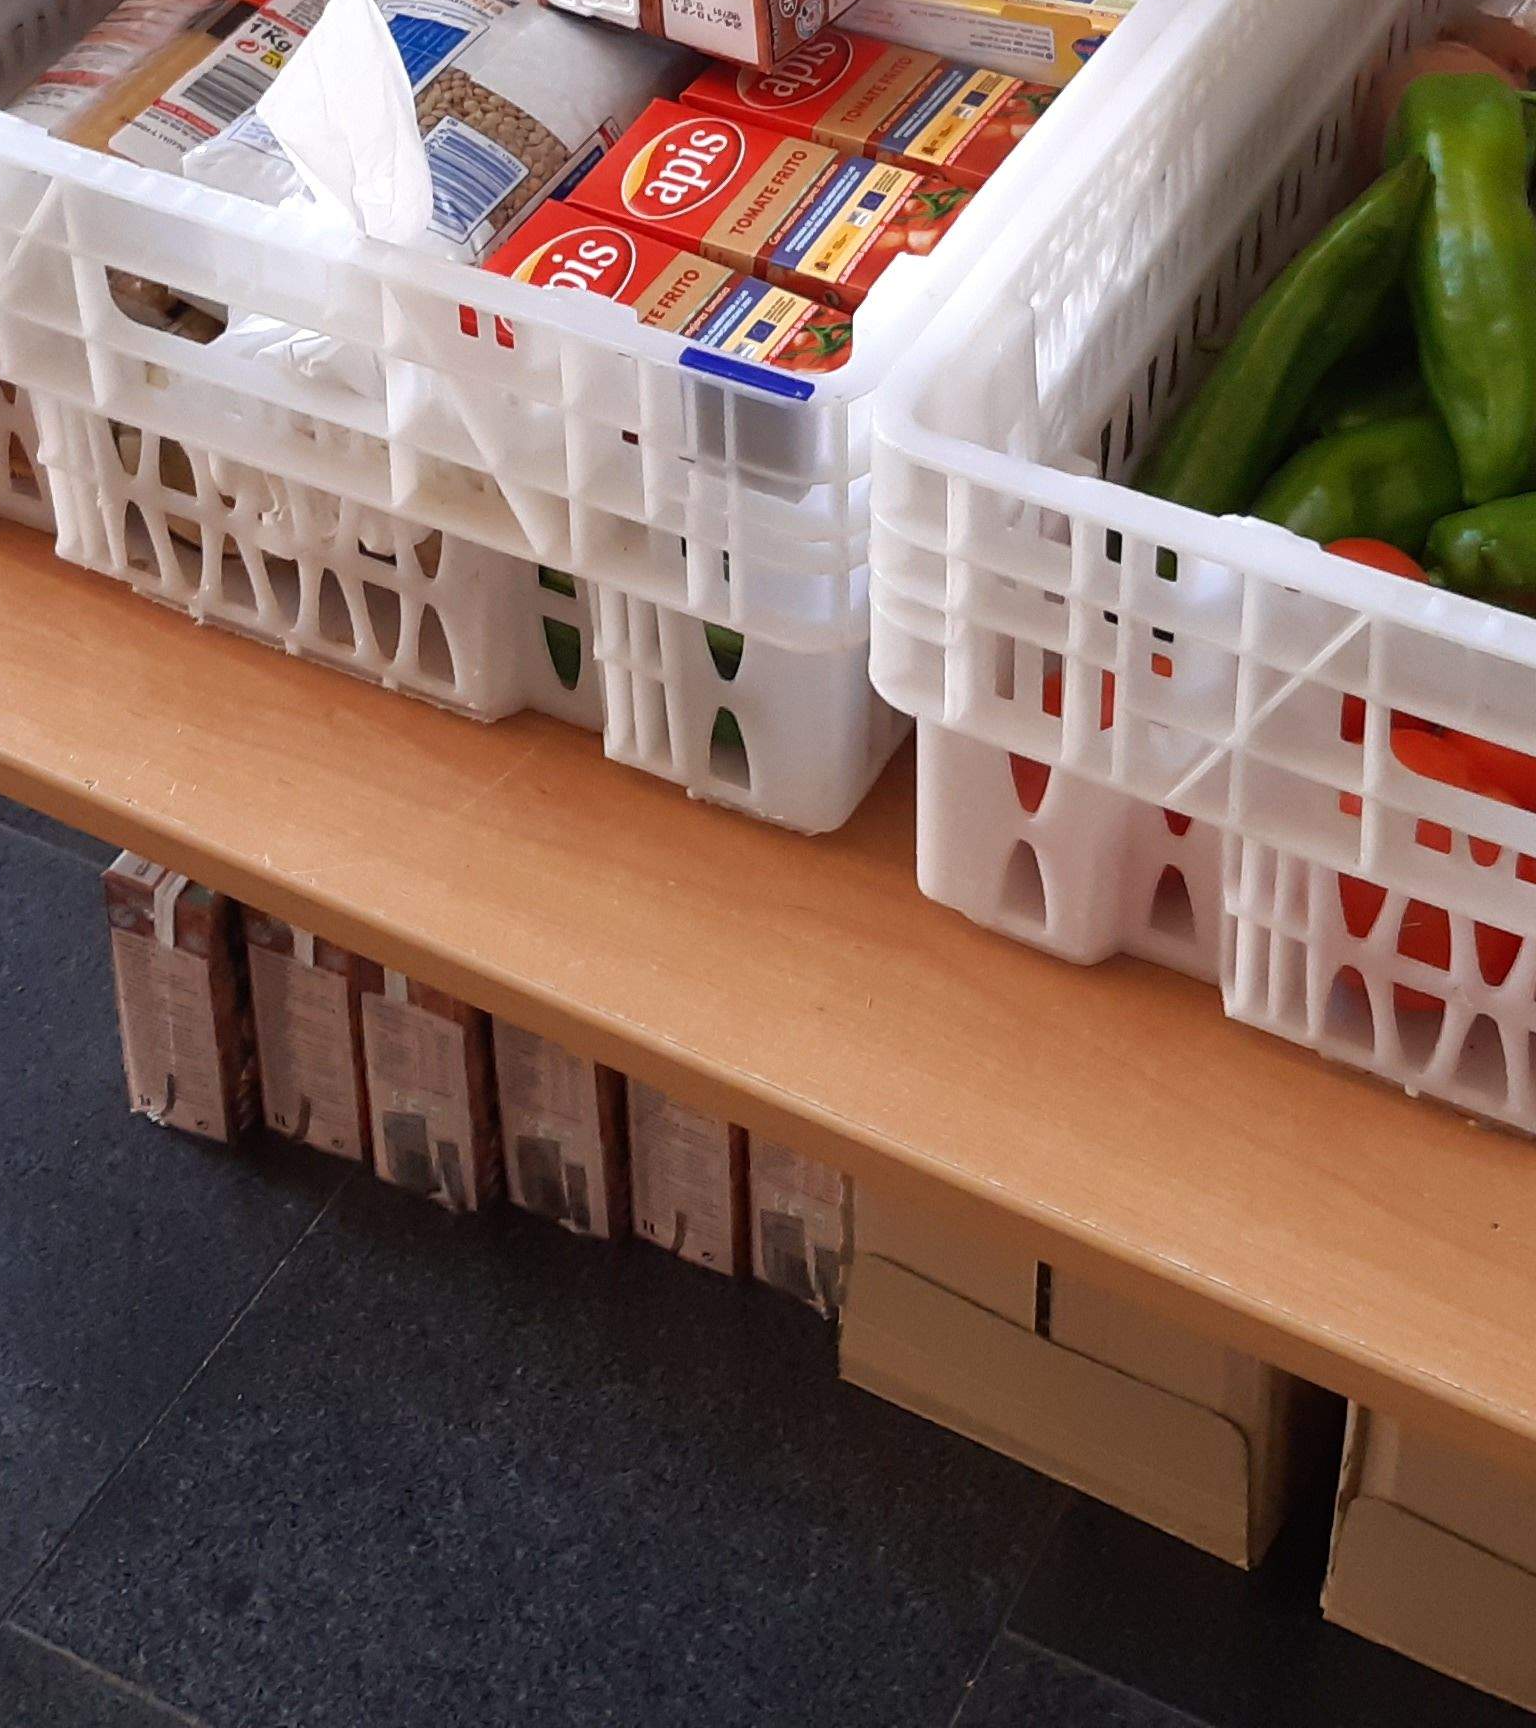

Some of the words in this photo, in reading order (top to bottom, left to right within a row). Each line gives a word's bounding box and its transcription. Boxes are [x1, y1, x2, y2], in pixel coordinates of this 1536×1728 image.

[759, 39, 837, 98] apis
[840, 81, 887, 124] TOMATE
[883, 56, 913, 88] FRITO
[643, 129, 729, 206] apis
[729, 181, 781, 237] TOMATE
[775, 149, 809, 187] FRITO
[542, 239, 620, 291] pis
[662, 268, 701, 311] FRITO
